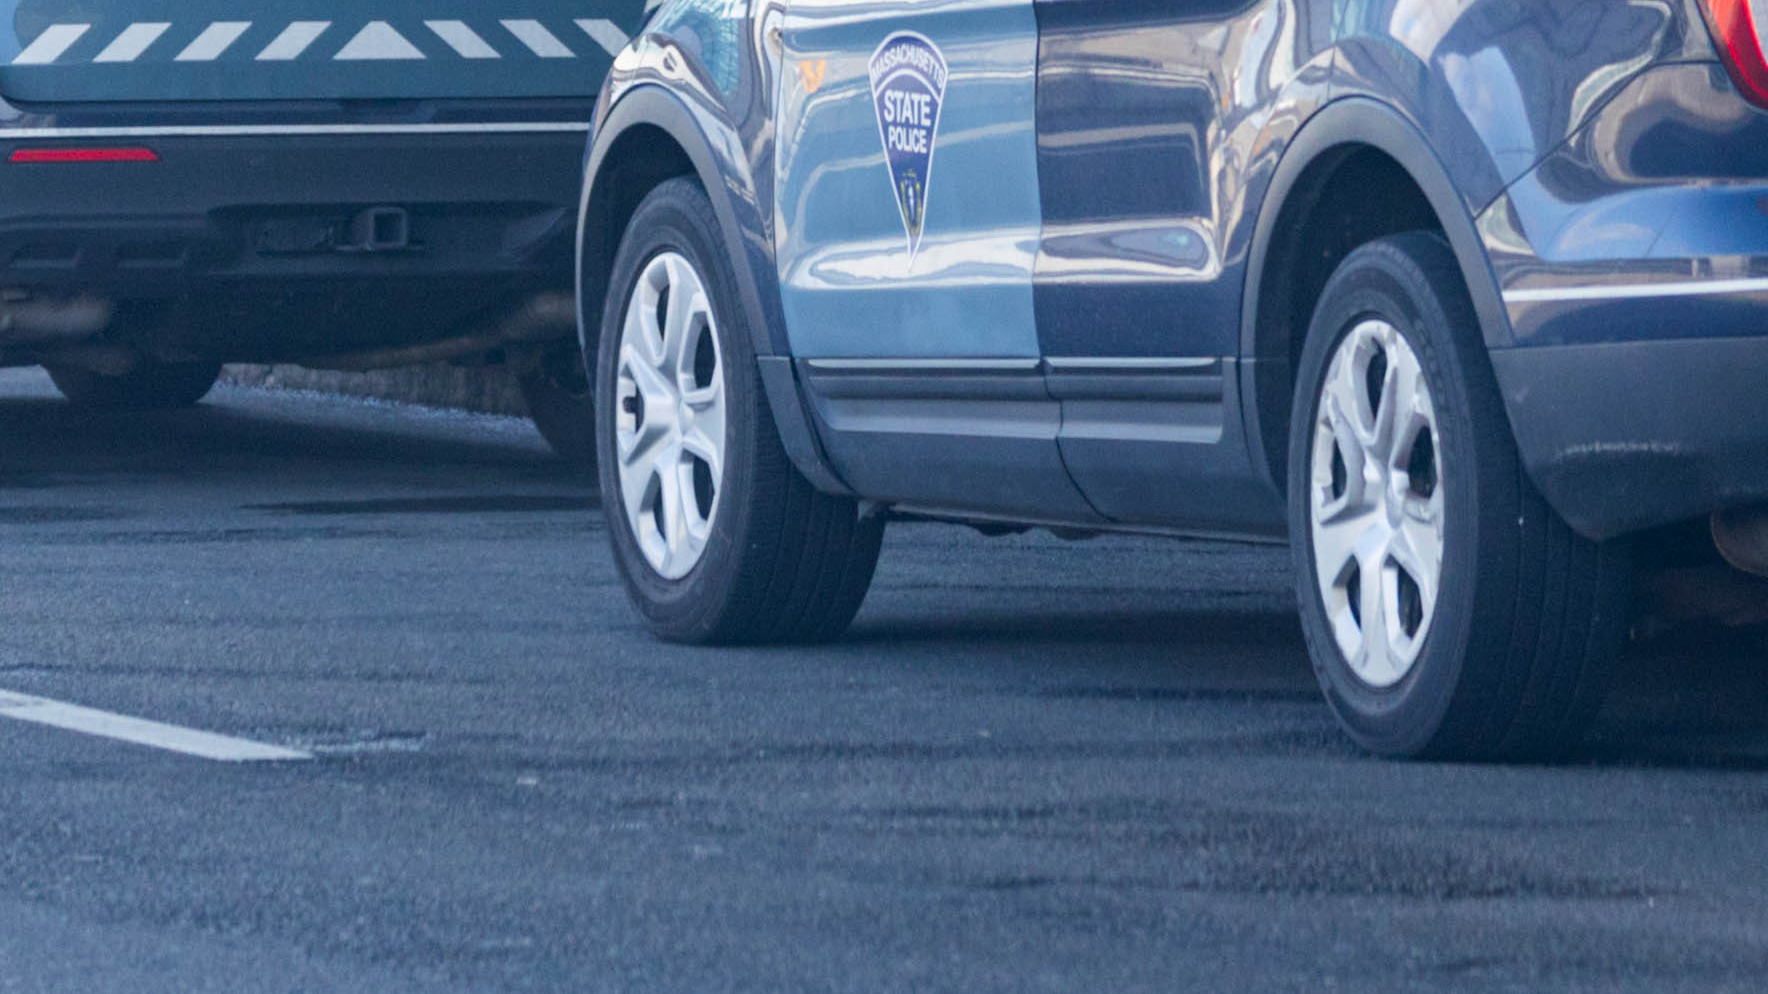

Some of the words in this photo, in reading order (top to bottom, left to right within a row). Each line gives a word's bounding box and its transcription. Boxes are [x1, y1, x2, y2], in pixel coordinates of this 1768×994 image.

[871, 43, 945, 89] MASSACHUSETTS
[883, 89, 932, 127] STATE
[888, 125, 928, 154] POLICE
